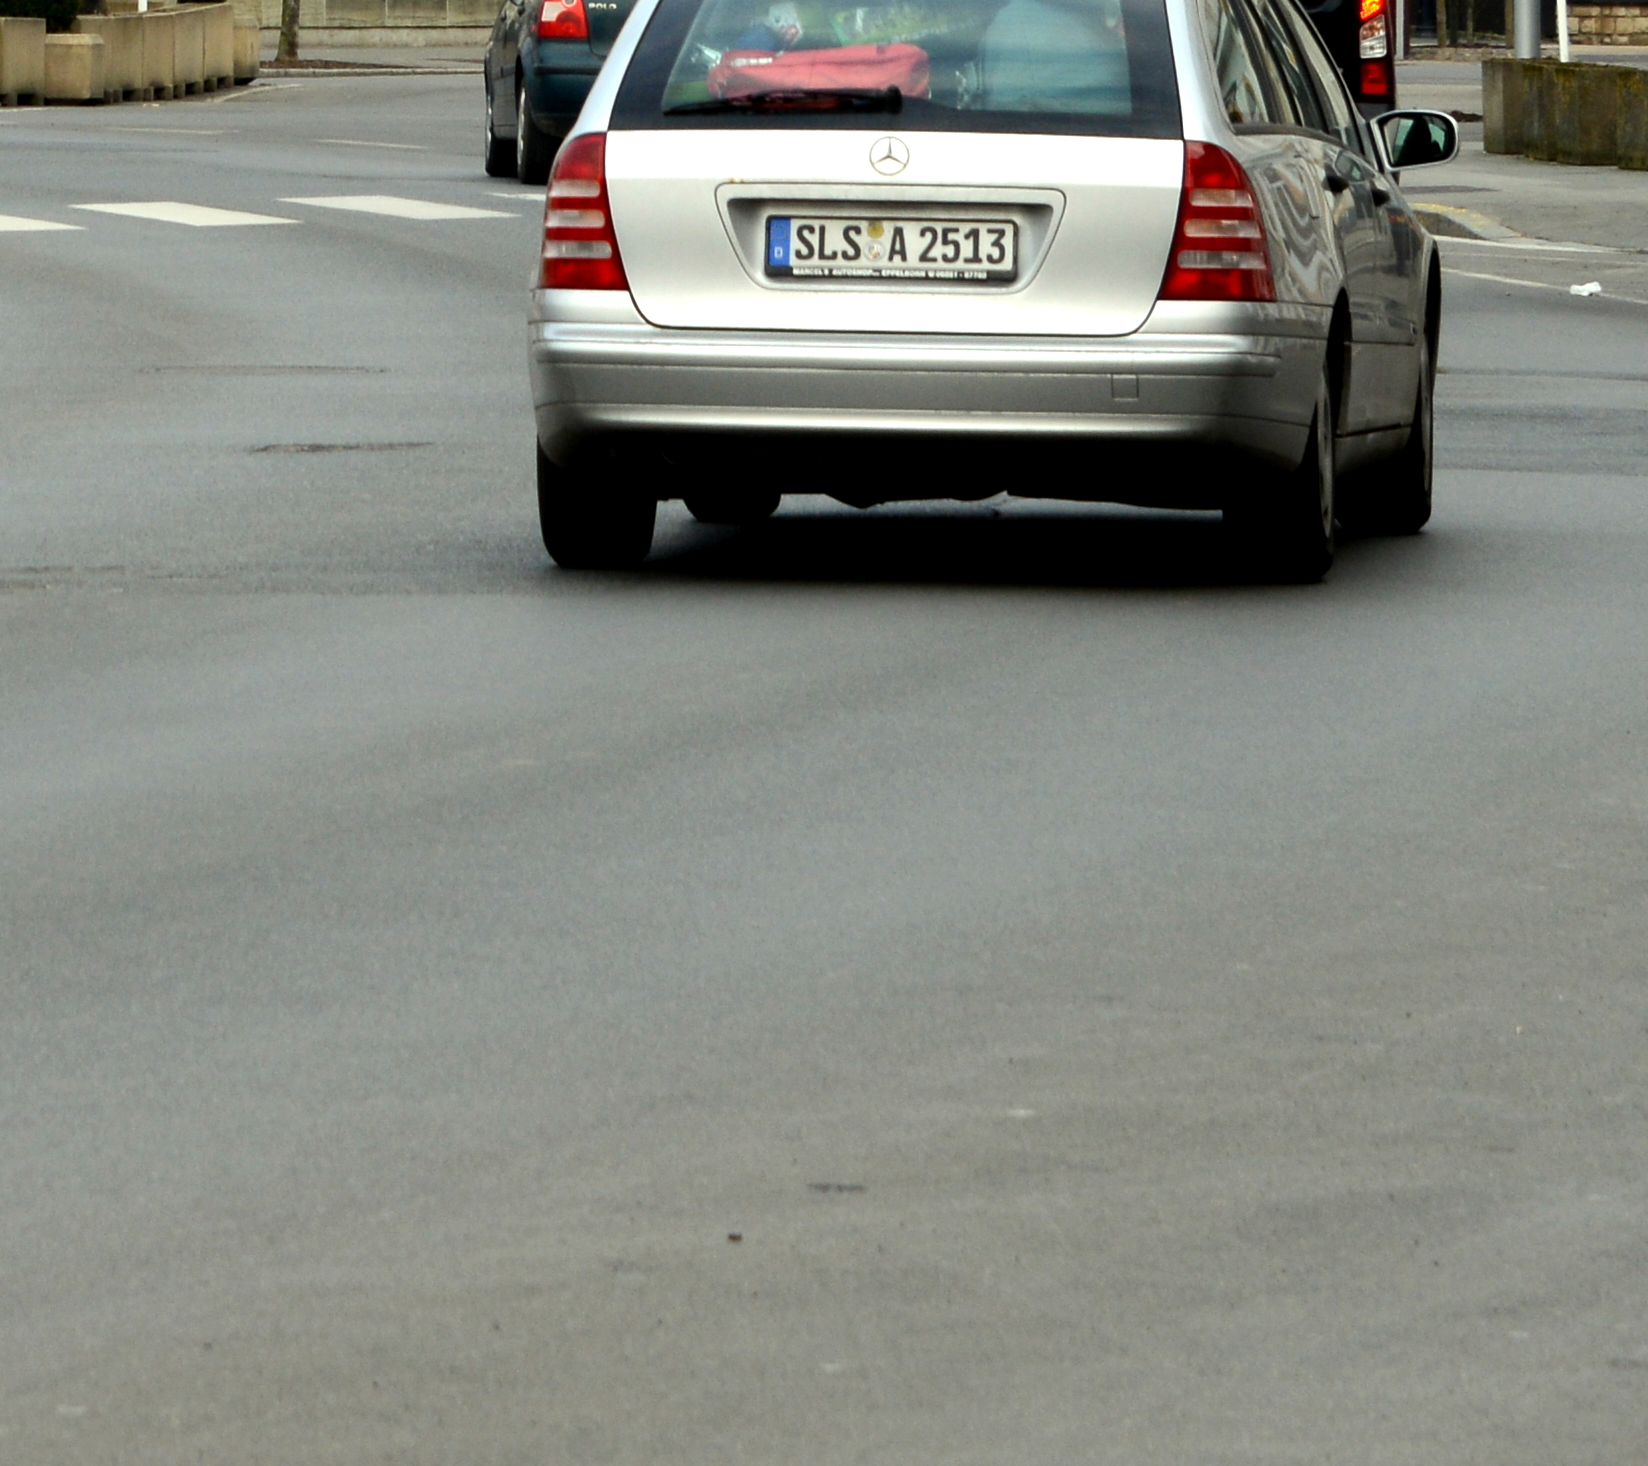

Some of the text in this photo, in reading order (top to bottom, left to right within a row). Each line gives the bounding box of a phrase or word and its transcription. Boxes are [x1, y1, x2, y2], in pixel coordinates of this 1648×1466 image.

[793, 224, 862, 261] SLS
[888, 226, 908, 263] A
[918, 225, 1006, 265] 2513
